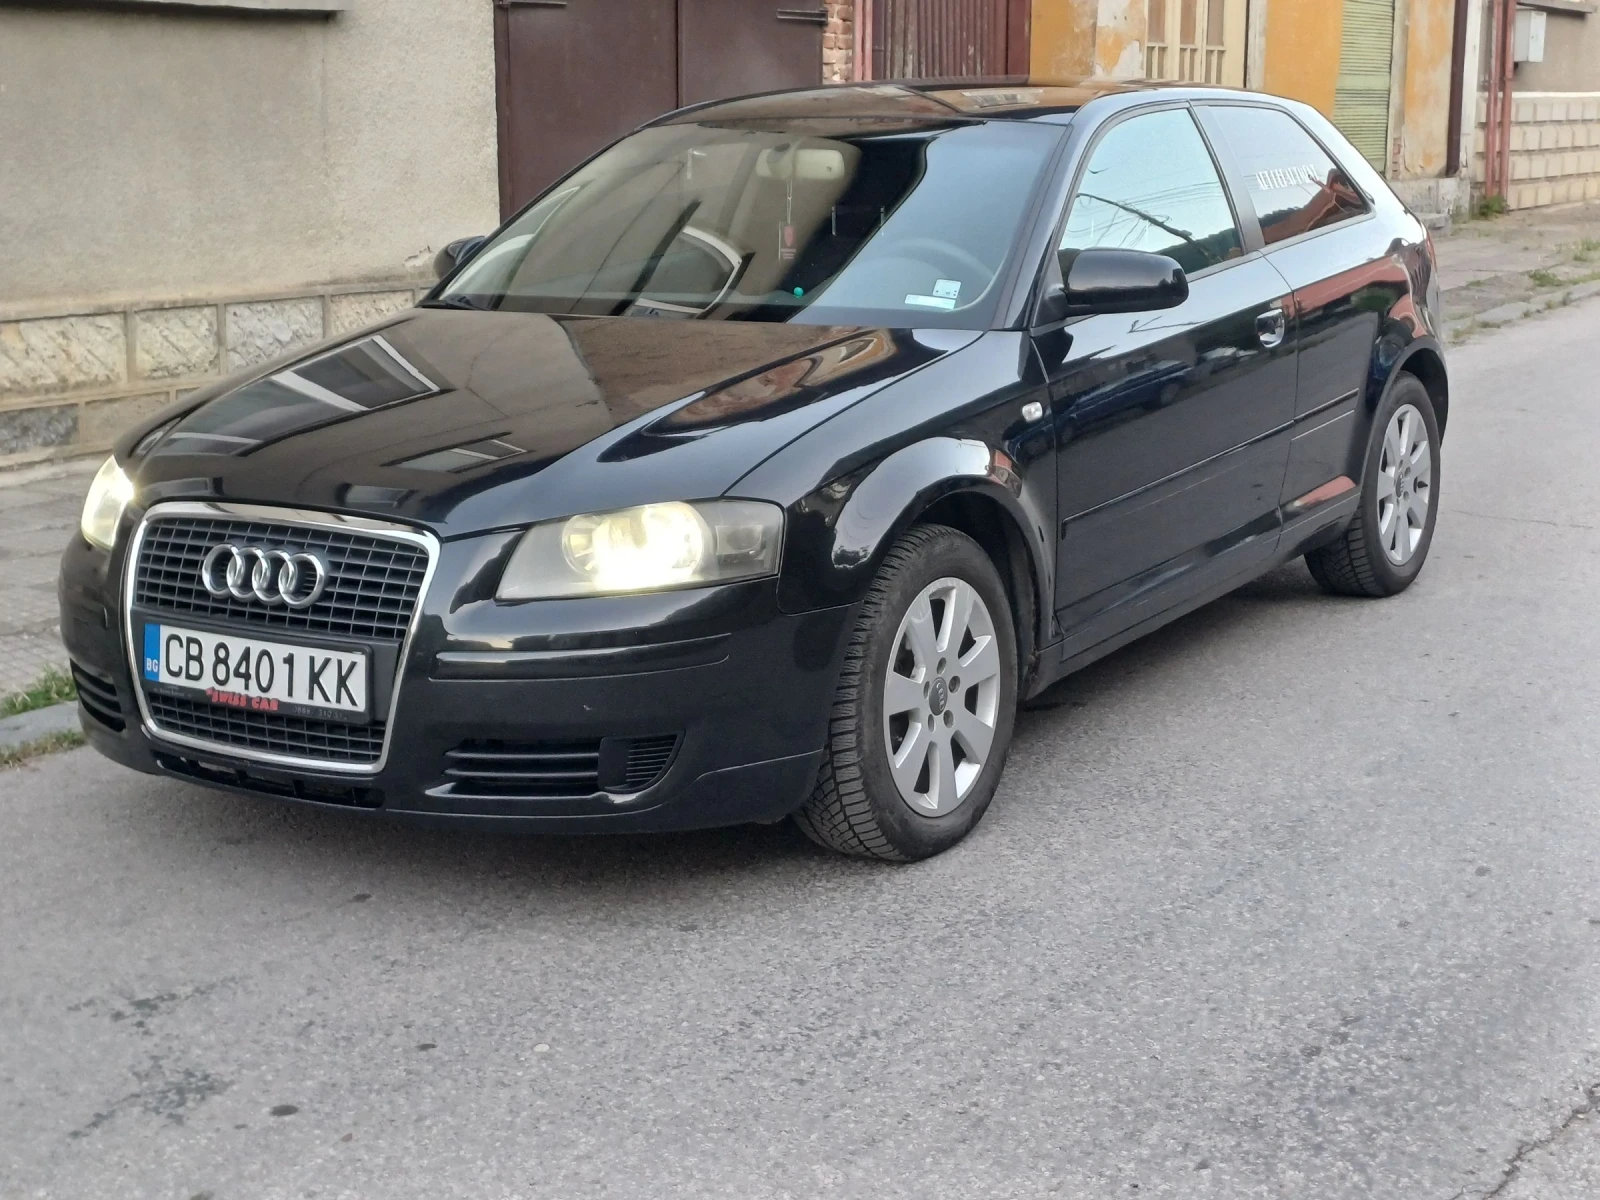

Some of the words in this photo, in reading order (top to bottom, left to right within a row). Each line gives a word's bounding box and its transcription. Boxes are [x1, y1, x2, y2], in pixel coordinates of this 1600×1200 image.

[146, 659, 159, 672] BG
[165, 633, 204, 681] CB
[212, 641, 294, 698] 8401
[308, 655, 358, 707] KK
